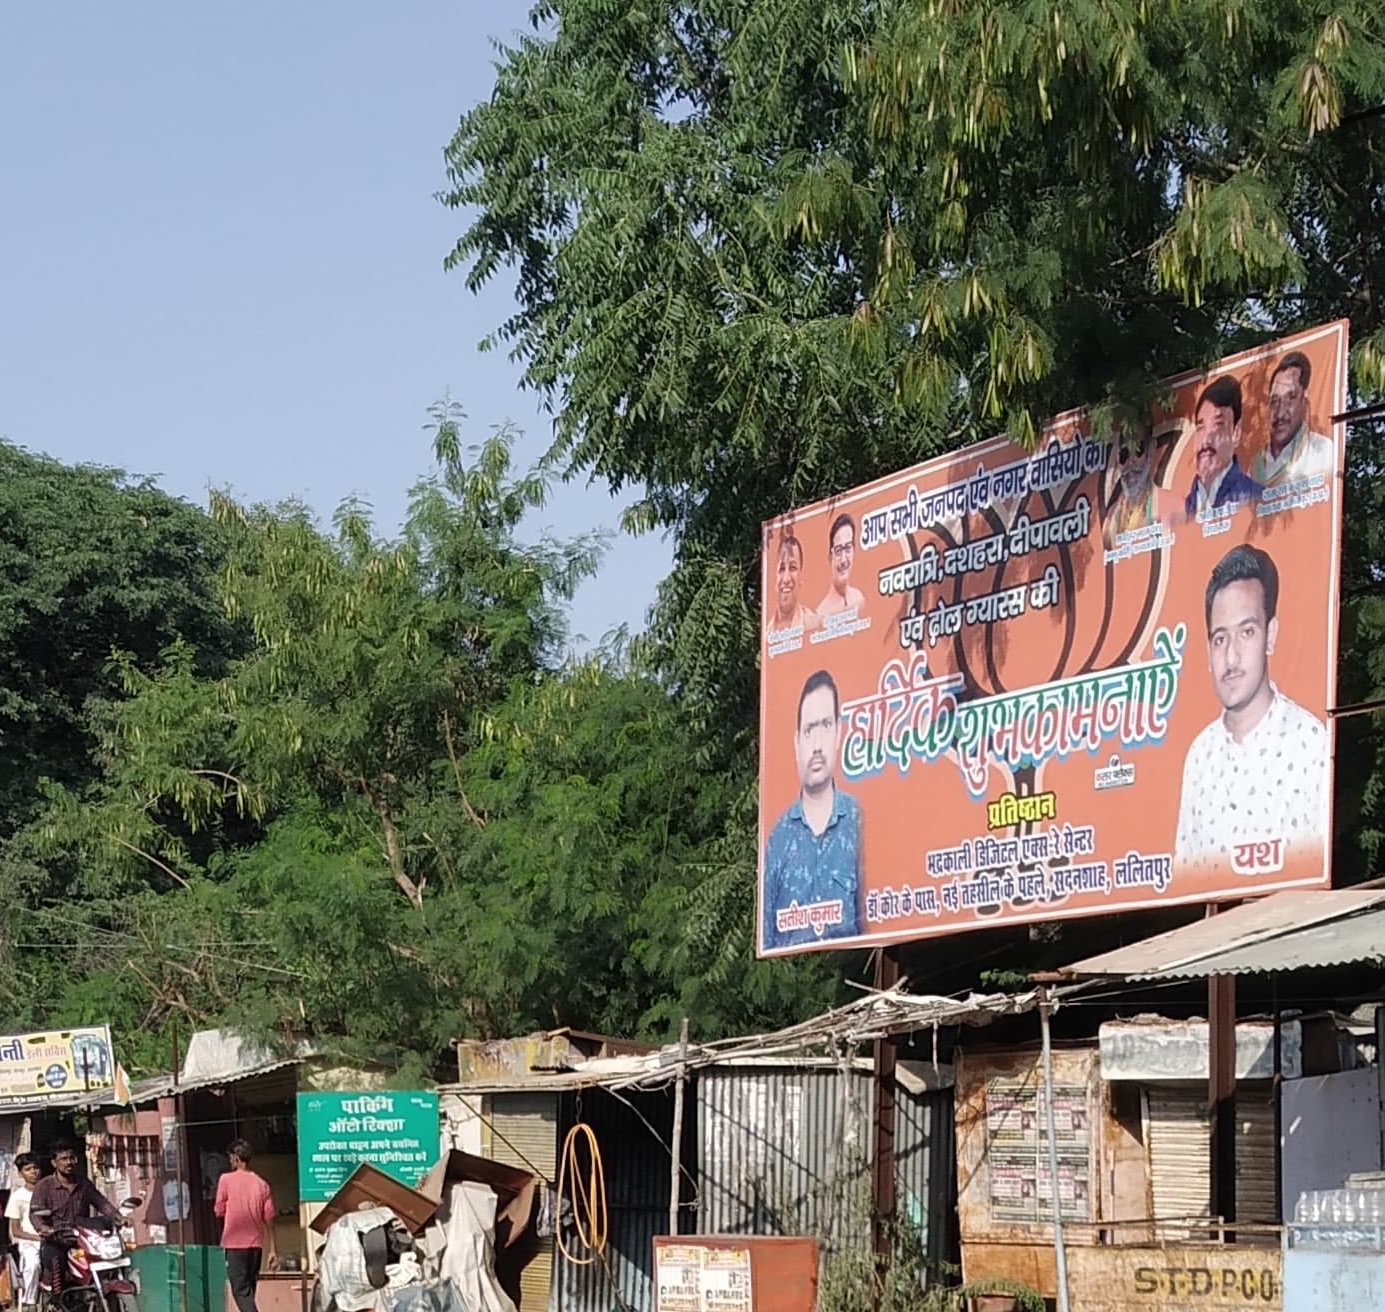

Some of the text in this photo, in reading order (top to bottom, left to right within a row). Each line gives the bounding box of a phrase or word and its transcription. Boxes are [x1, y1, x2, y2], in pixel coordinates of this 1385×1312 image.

[862, 510, 886, 546] आप
[891, 489, 918, 533] सभी
[921, 486, 966, 523] जनपद
[994, 464, 1028, 498] नगर
[1030, 567, 1059, 608] की
[843, 652, 963, 772] हार्दिक
[988, 794, 1055, 828] प्रतिष्ठान
[928, 843, 971, 874] भद्रकाली
[975, 838, 1018, 866] डिजिटल
[1063, 826, 1093, 854] सेन्टर
[1234, 838, 1282, 869] यश
[902, 888, 911, 912] के
[943, 881, 958, 909] नई
[961, 875, 1000, 905] तहसील
[1004, 873, 1014, 898] के
[1115, 854, 1171, 889] ललितपुर
[778, 902, 841, 932] सतीश कुमार
[329, 1116, 405, 1133] ऑटो रिक्शा
